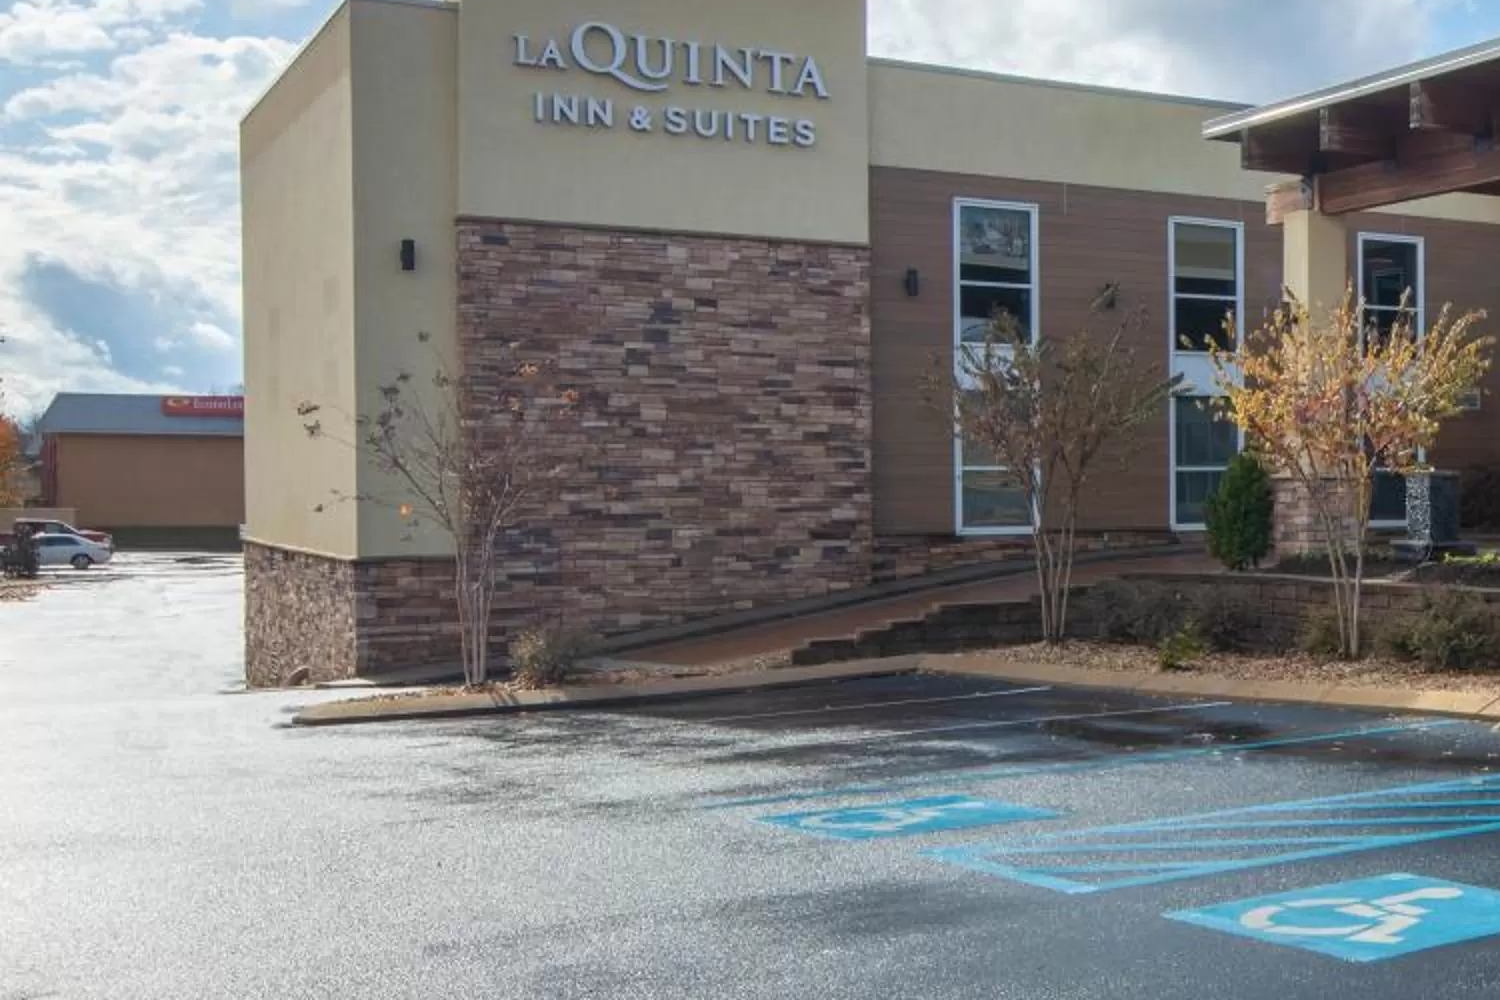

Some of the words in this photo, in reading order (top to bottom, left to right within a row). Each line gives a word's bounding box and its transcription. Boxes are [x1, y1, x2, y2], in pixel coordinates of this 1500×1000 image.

[513, 34, 567, 70] LA
[570, 22, 831, 98] QUINTA
[534, 91, 613, 127] INN
[630, 105, 653, 132] &
[664, 107, 817, 147] SUITES
